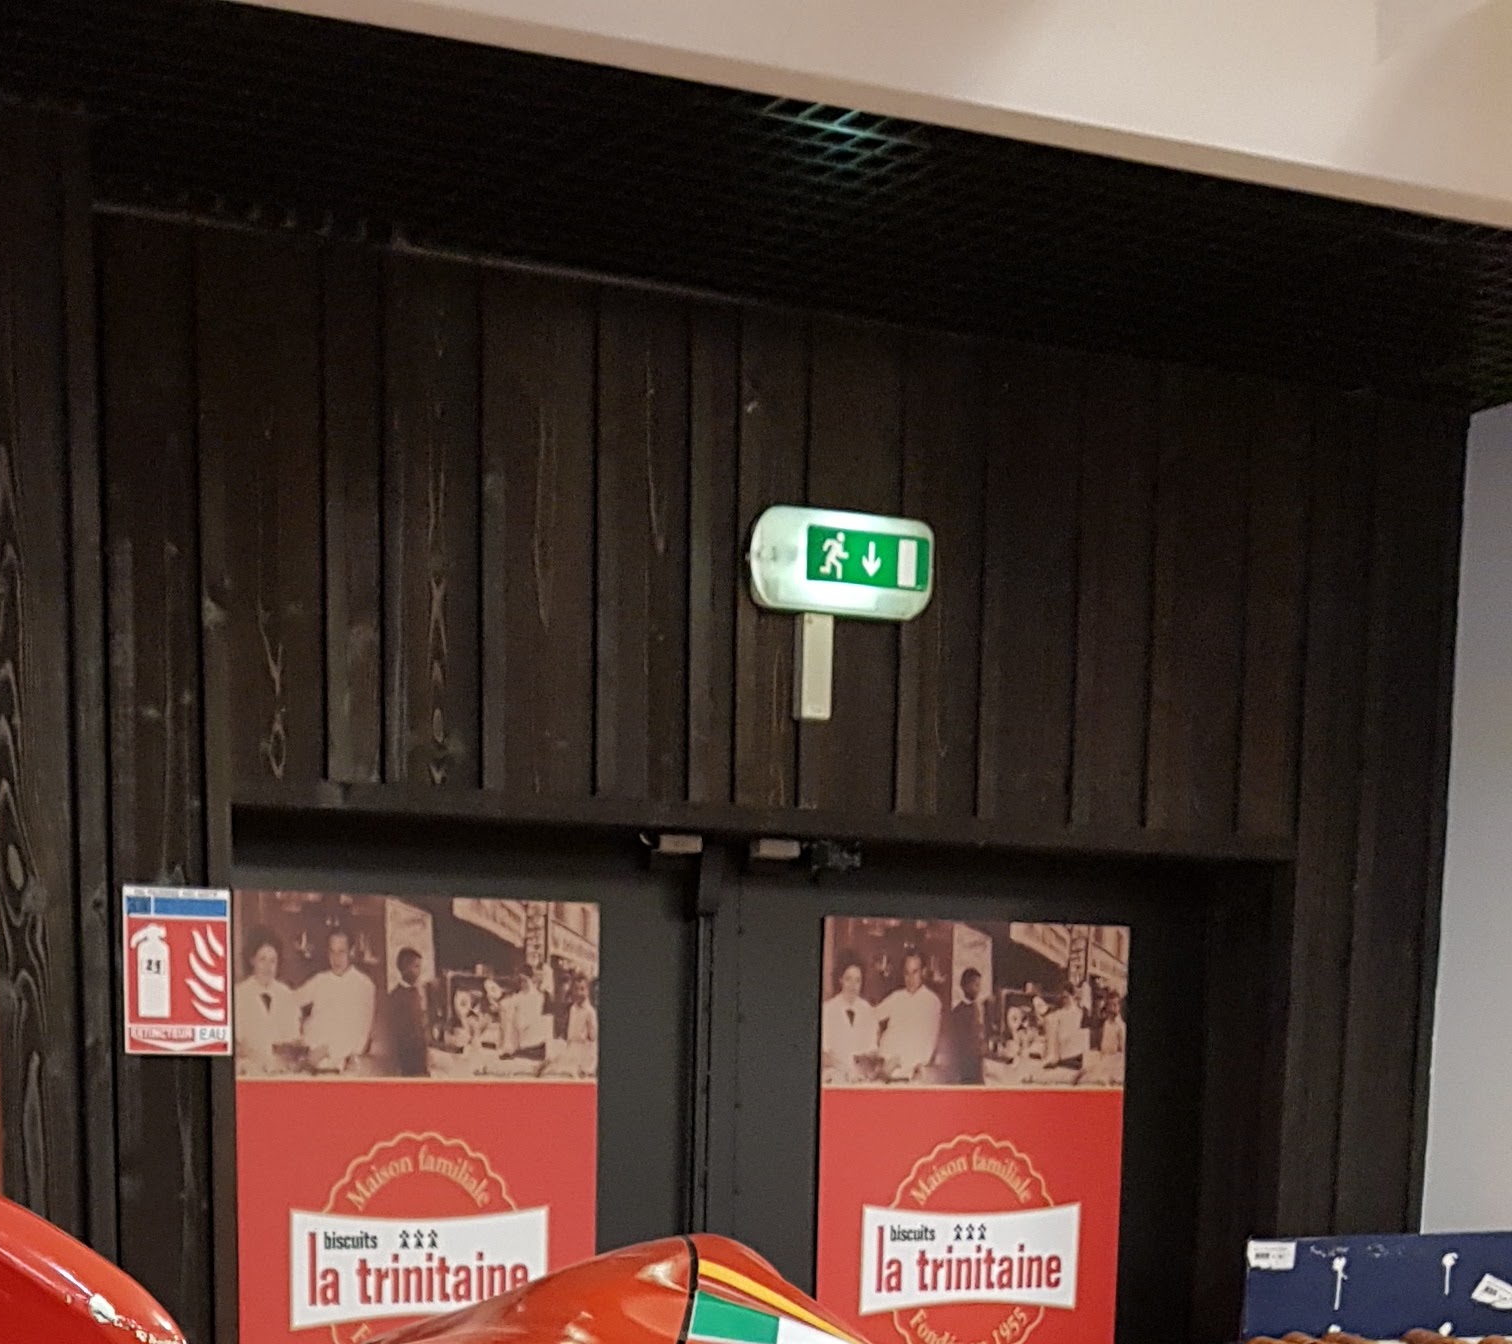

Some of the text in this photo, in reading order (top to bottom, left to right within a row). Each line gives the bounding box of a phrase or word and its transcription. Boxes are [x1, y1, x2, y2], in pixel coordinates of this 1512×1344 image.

[199, 1027, 226, 1041] EAU
[346, 1144, 489, 1211] Maison familiale
[910, 1146, 1032, 1206] Maison familiale
[324, 1230, 378, 1250] biscuits
[875, 1225, 1062, 1293] la trinitaine
[890, 1224, 936, 1242] biscuits
[308, 1231, 529, 1306] la trinitaine
